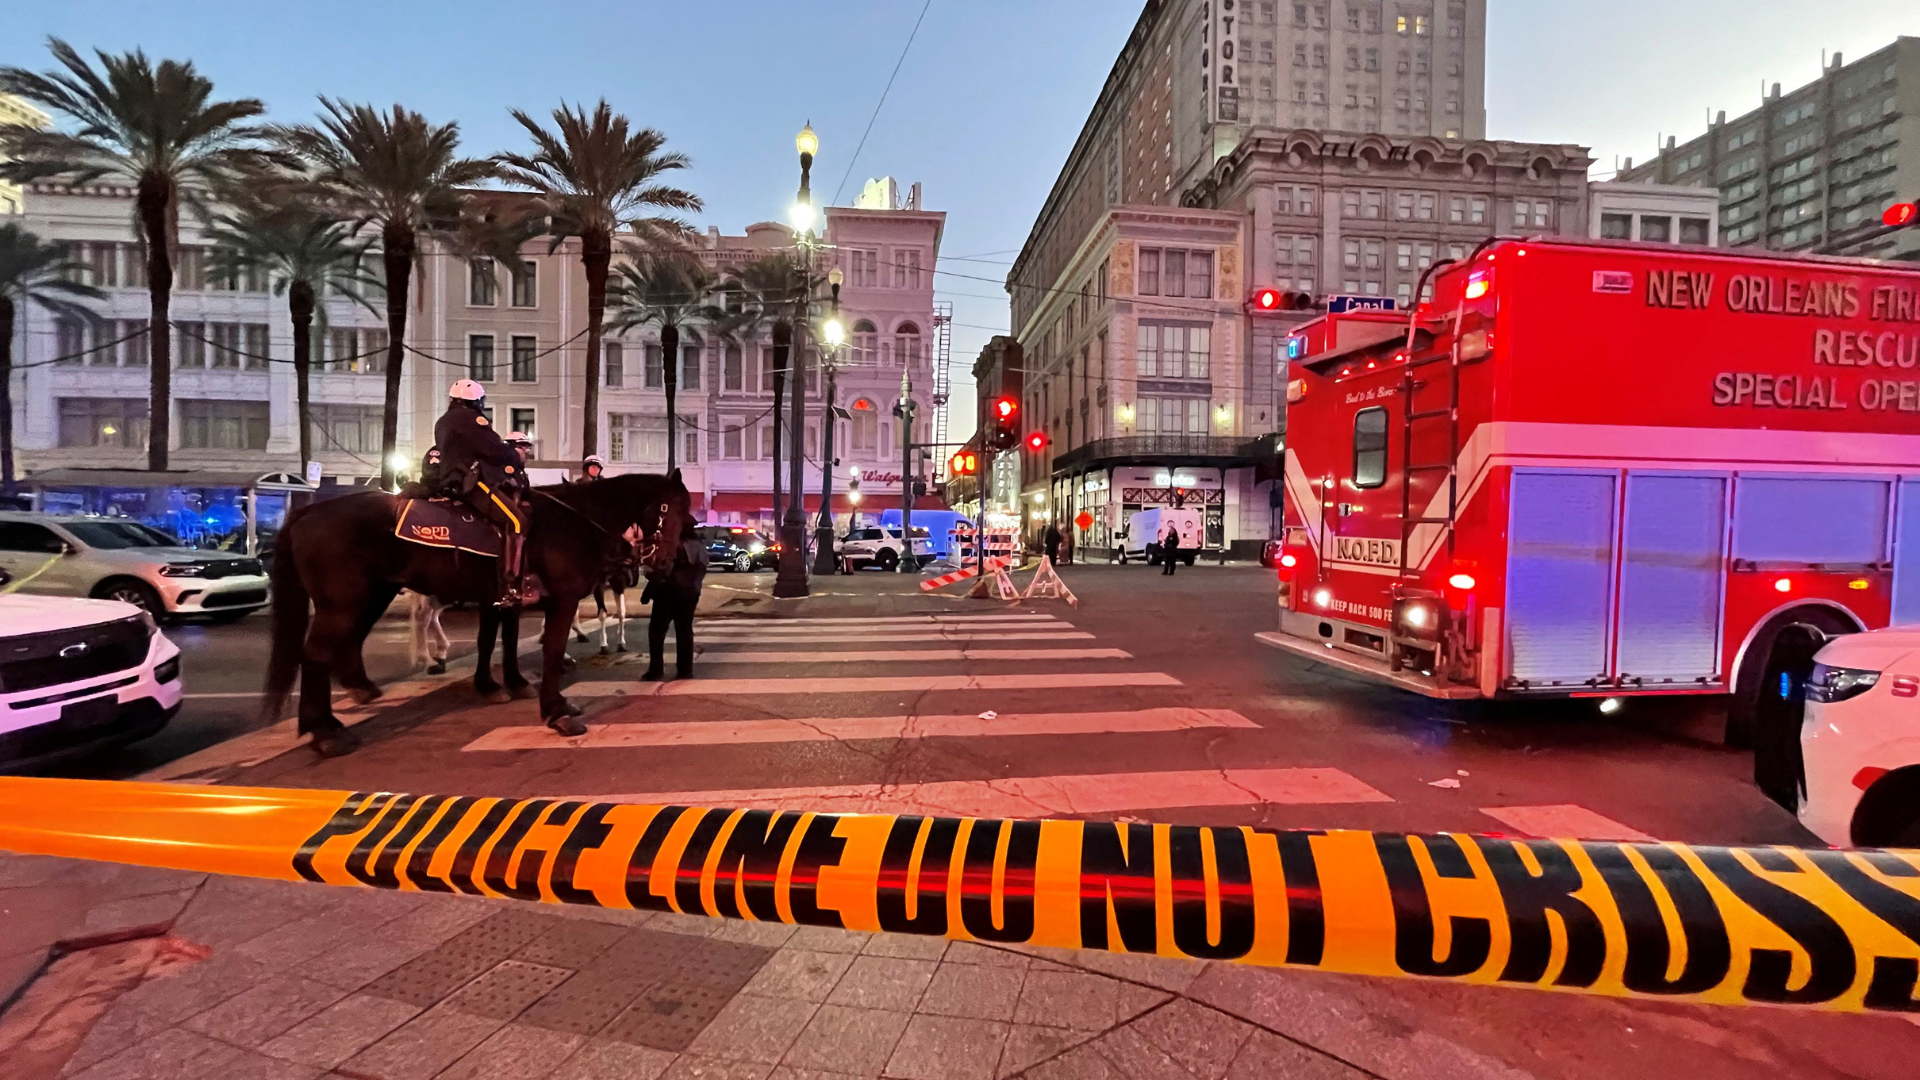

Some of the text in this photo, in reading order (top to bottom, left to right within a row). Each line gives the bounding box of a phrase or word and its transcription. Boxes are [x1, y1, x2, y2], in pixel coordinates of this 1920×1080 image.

[1345, 297, 1385, 311] Canal
[1646, 269, 1714, 309] NEW
[1727, 274, 1859, 318] ORLEANS
[1814, 329, 1920, 368] RESCU
[1713, 371, 1920, 412] SPECIAL OPE
[861, 469, 928, 487] Walgr
[1337, 538, 1399, 564] N.O.F.D.
[1330, 599, 1393, 622] KEEP BACK 500 FE
[292, 791, 617, 904] POLICE
[625, 804, 848, 927] LINE
[876, 815, 1041, 943] DO
[1081, 820, 1328, 966] NOT
